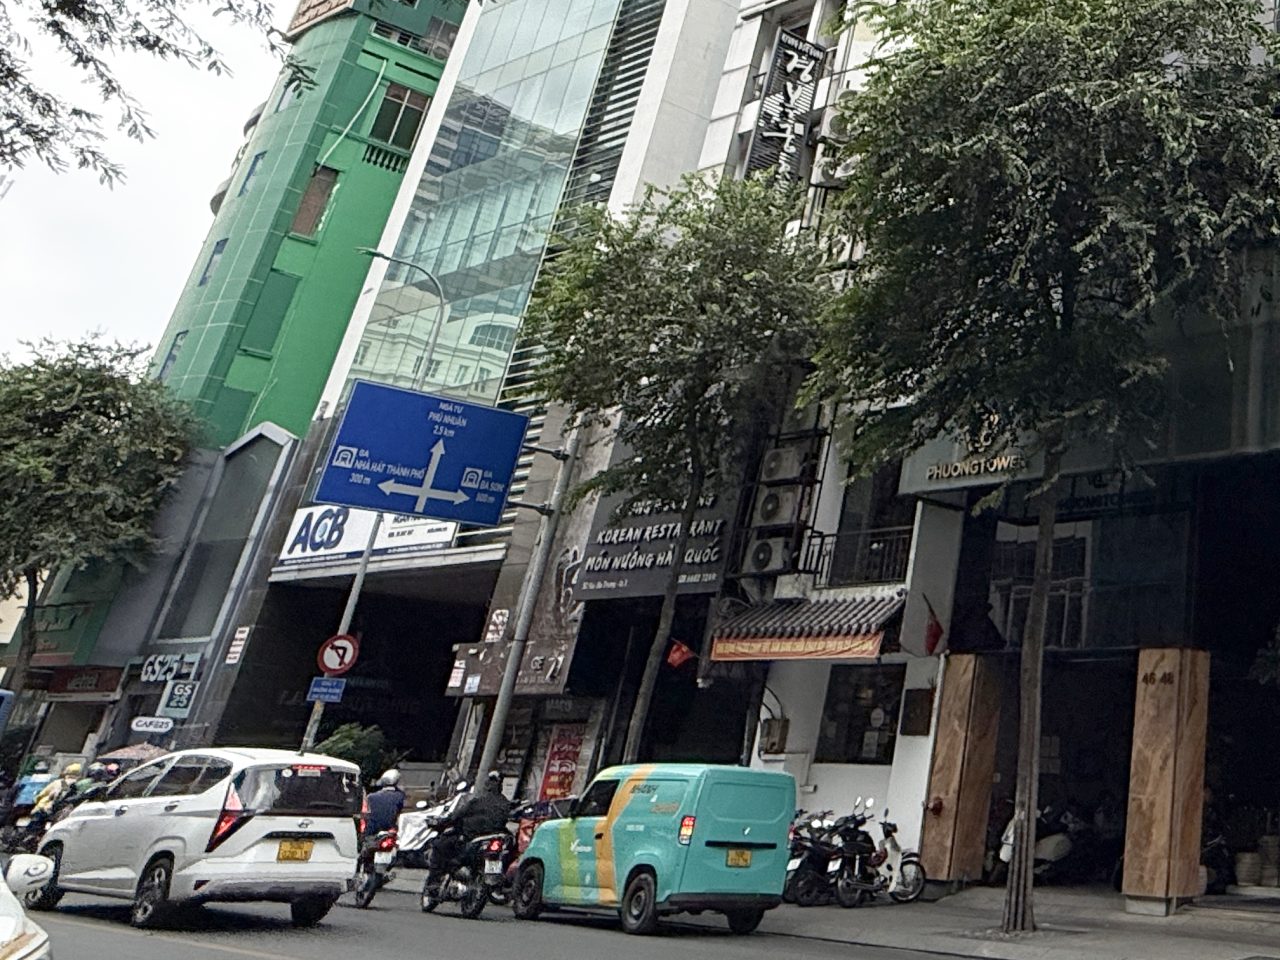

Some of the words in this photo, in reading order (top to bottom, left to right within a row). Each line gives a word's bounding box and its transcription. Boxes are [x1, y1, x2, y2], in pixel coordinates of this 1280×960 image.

[288, 507, 350, 554] ACB
[597, 526, 643, 544] KOREAN
[643, 519, 723, 542] RESTARANT
[585, 551, 610, 571] MÓN
[684, 538, 720, 563] QUỐC
[141, 653, 180, 681] GS25
[169, 695, 187, 707] 25
[173, 684, 192, 695] GS
